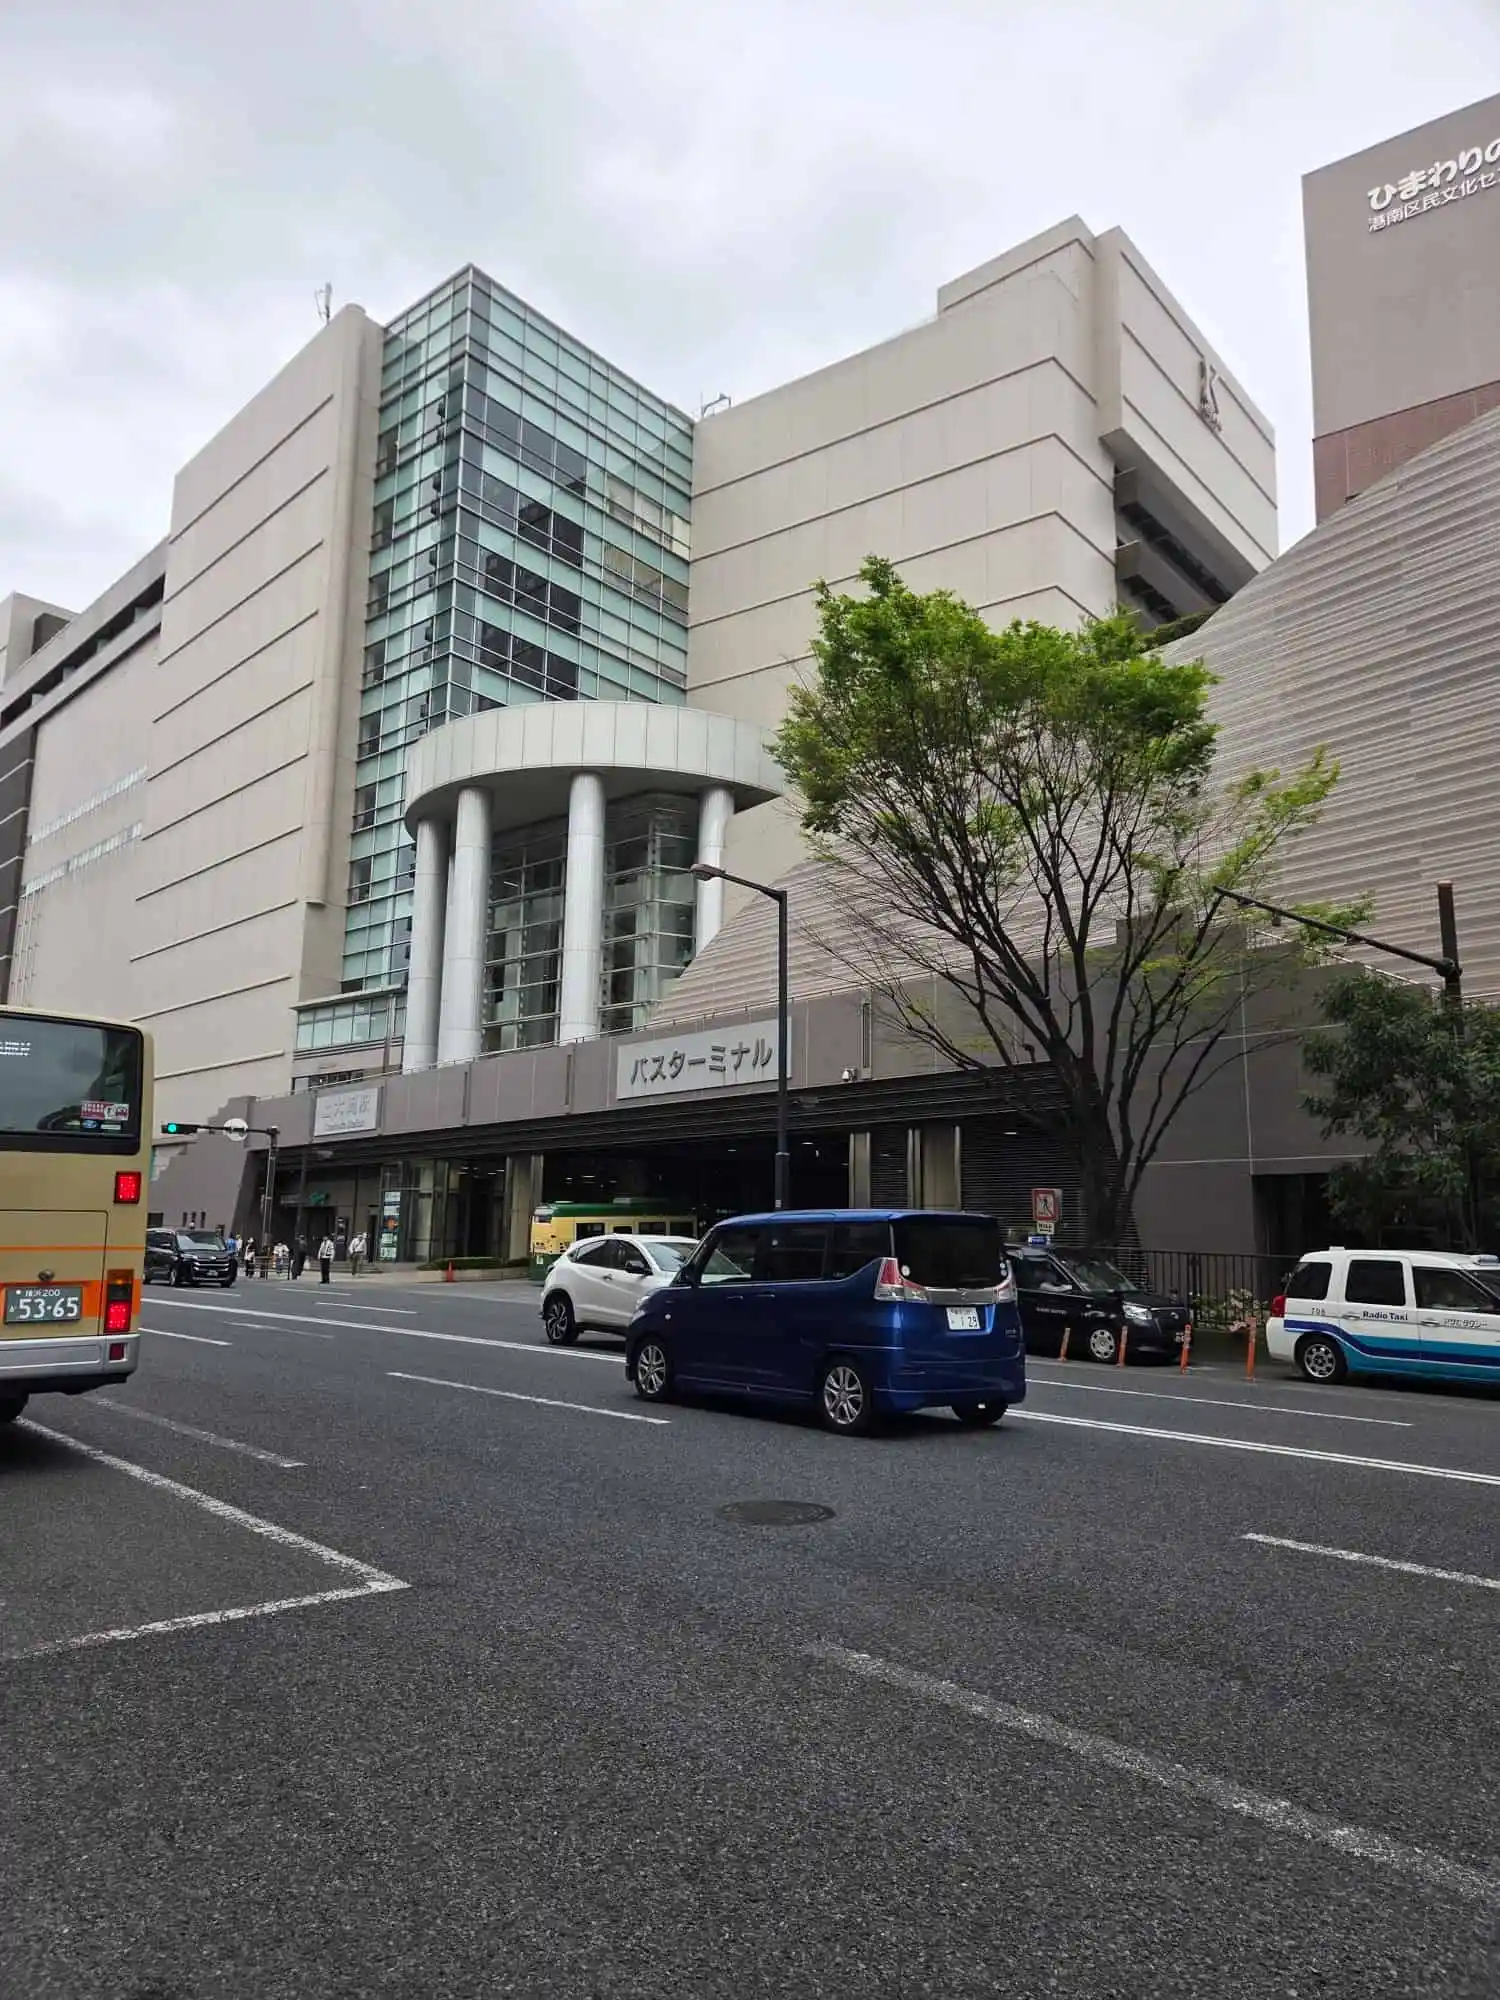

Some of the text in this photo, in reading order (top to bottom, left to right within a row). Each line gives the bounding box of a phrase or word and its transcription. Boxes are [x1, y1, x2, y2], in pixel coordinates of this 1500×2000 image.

[1368, 168, 1500, 232] 港南区民文化セ
[630, 1037, 774, 1085] バスターミナル
[1362, 1310, 1408, 1321] Radio Taxi
